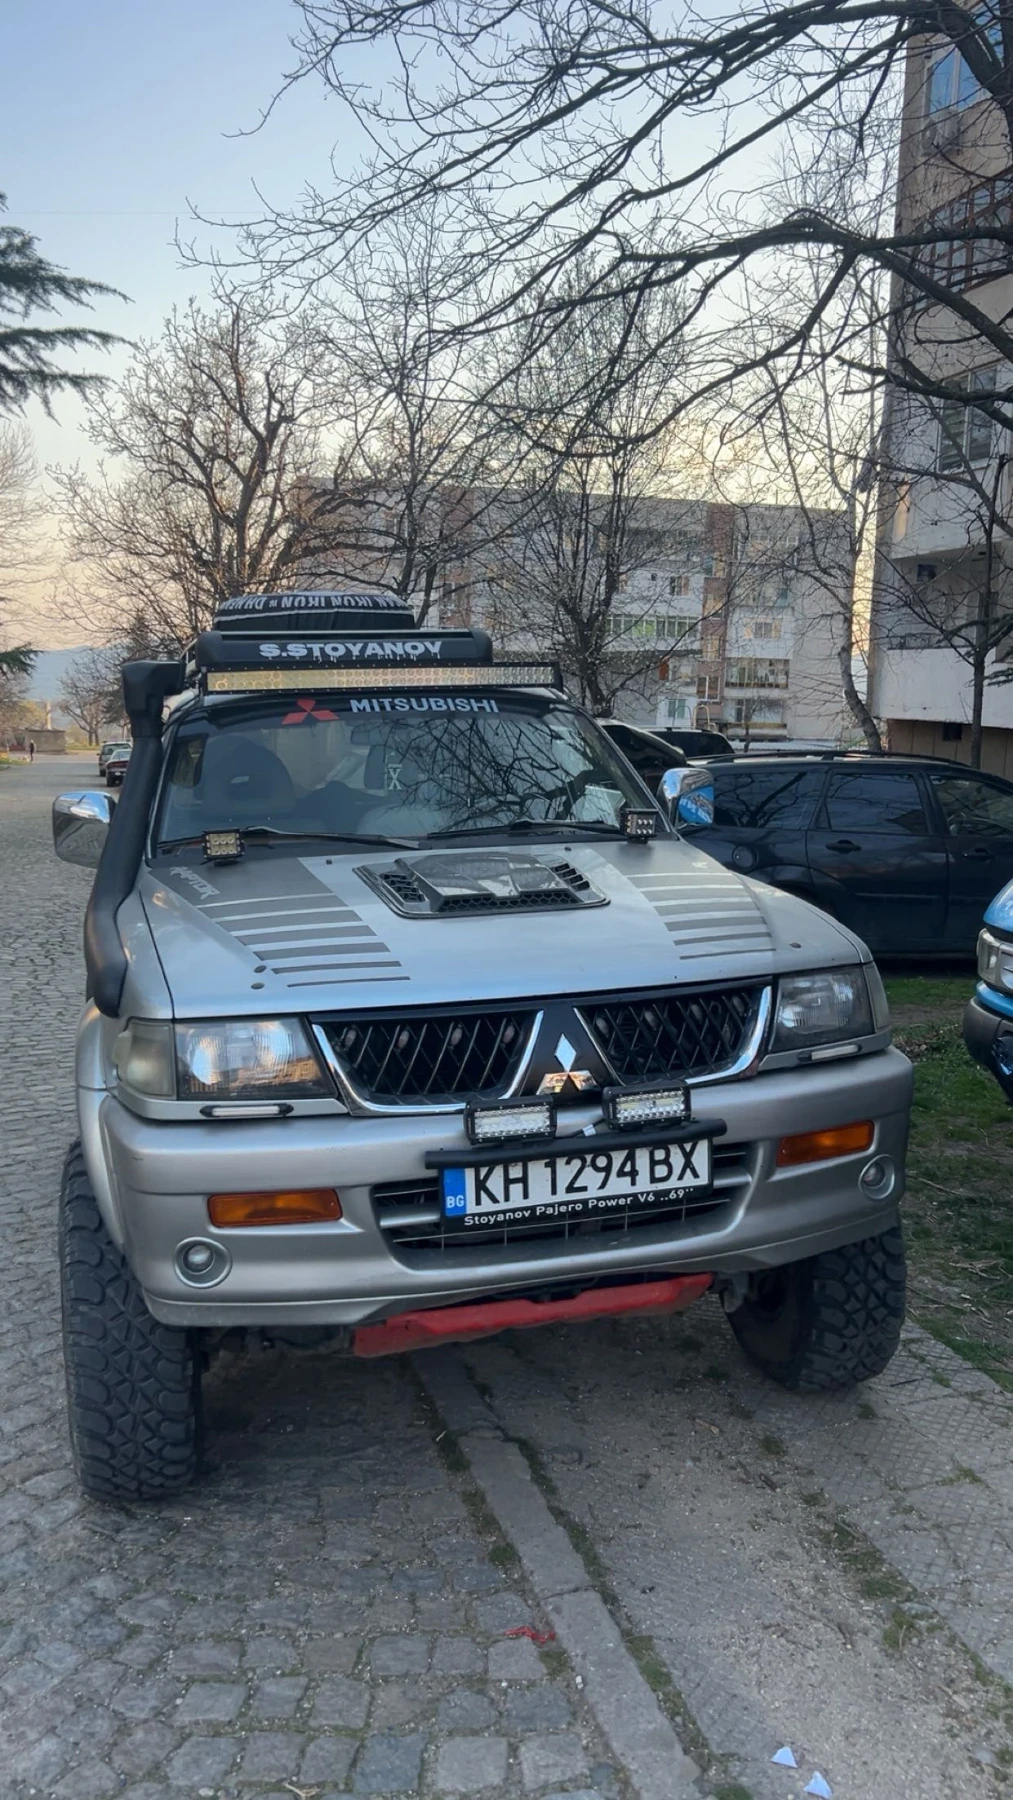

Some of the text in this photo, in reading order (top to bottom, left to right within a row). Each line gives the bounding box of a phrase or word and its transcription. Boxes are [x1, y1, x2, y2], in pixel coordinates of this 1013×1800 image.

[259, 641, 442, 661] S.STOYANOV
[350, 698, 499, 713] MITSUBISHI
[474, 1140, 701, 1206] KH 1294 BX
[445, 1195, 465, 1208] BG
[464, 1209, 531, 1226] Stoyanov
[536, 1202, 583, 1216] Pajero
[588, 1196, 633, 1209] Power
[638, 1192, 655, 1203] V6
